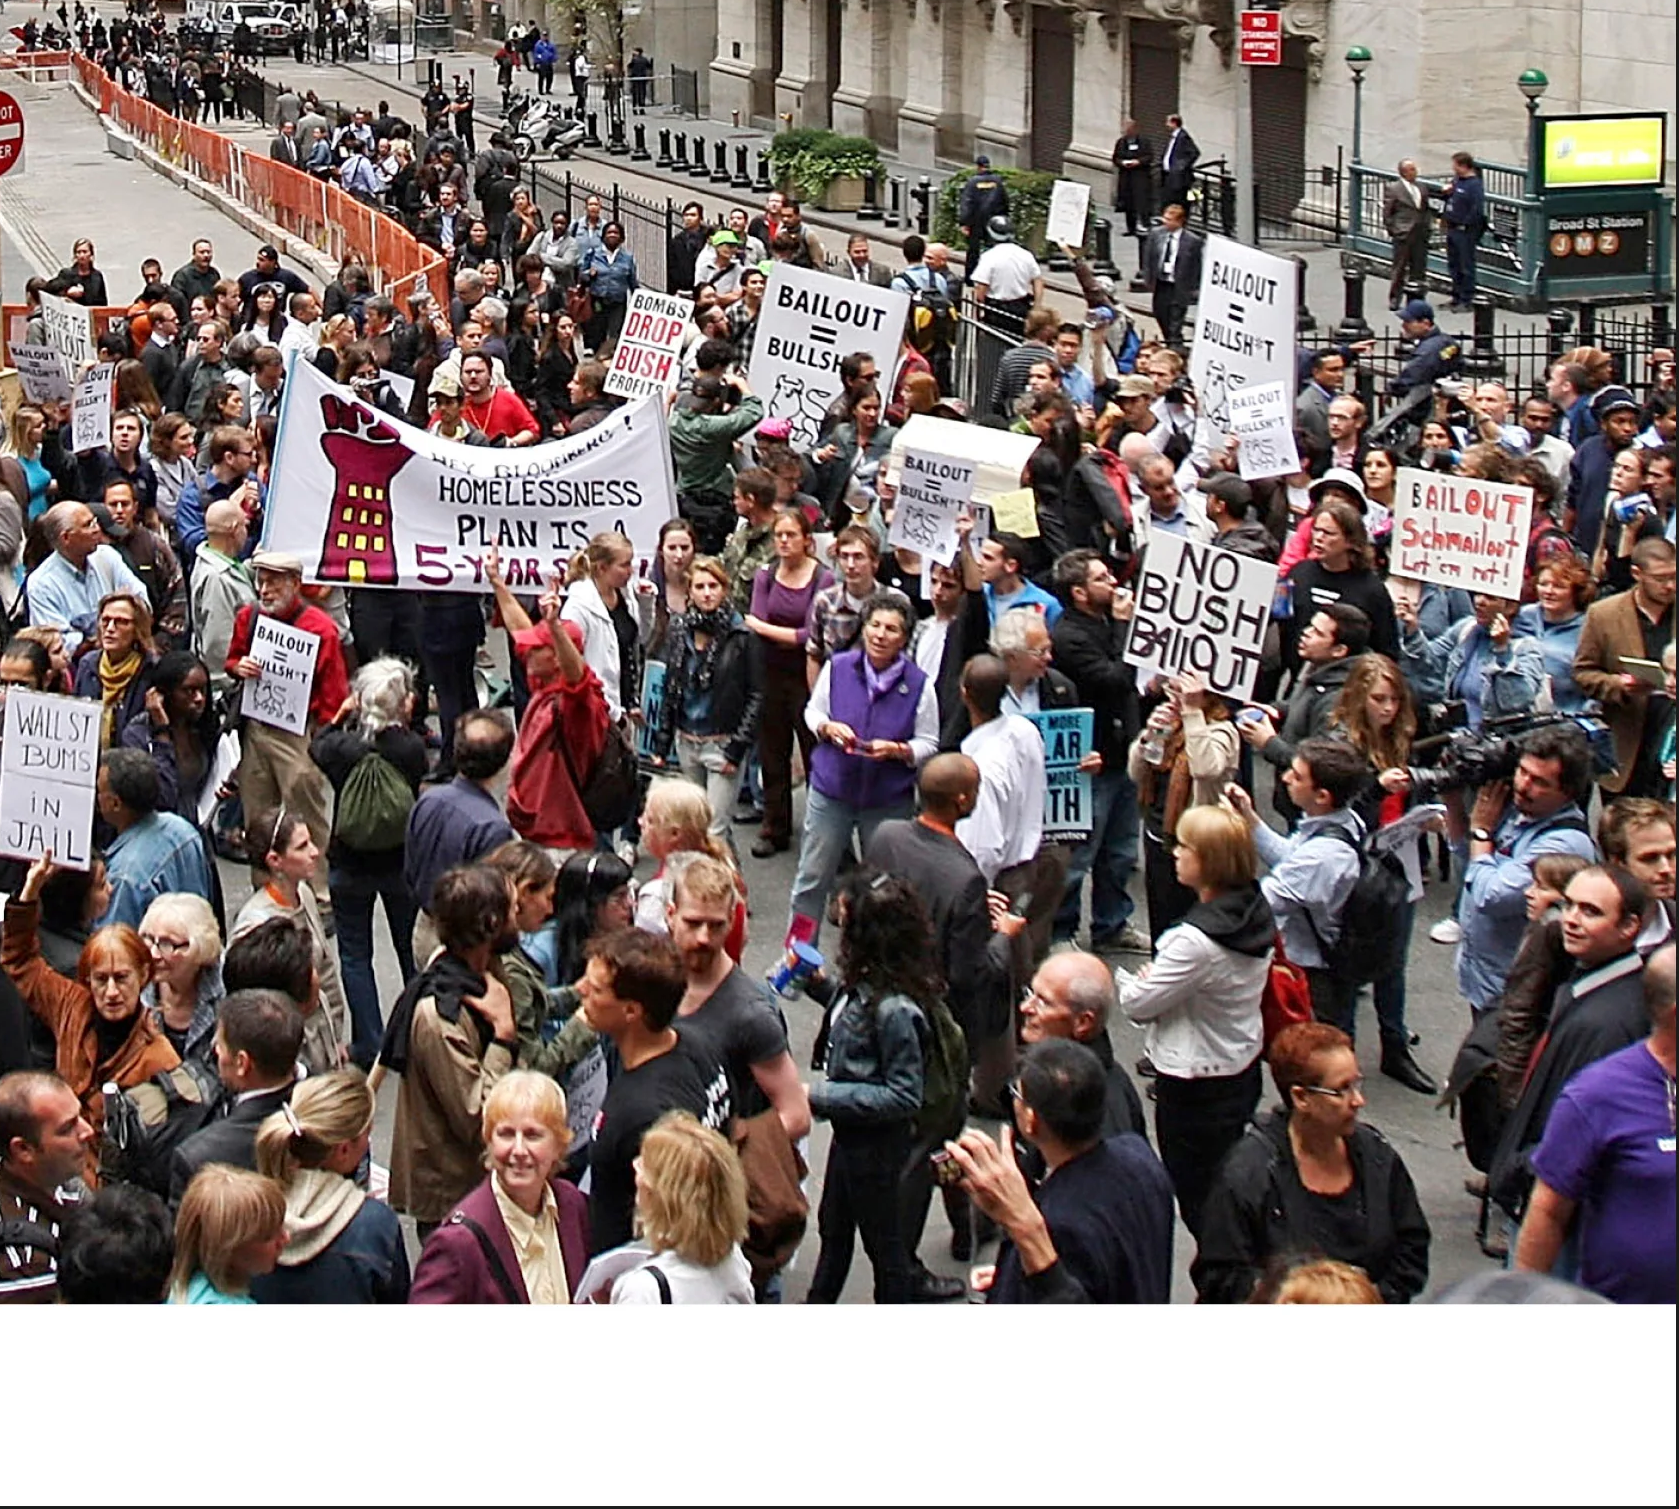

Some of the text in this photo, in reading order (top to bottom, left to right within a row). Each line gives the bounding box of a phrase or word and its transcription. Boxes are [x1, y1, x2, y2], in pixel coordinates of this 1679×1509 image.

[1548, 216, 1644, 231] Broad St Station
[1574, 238, 1593, 251] M
[1212, 260, 1278, 305] BAILOUT
[632, 293, 689, 319] BOMBS
[777, 284, 887, 331] BAILOUT
[626, 312, 683, 345] DROP
[615, 345, 673, 382] BUSH
[1231, 389, 1282, 410] BAILOUT
[905, 454, 973, 483] BAILOUT
[438, 474, 643, 508] HOMELESSNESS
[457, 513, 537, 548] PLAN
[550, 519, 590, 551] IS
[1176, 541, 1240, 593] NO
[1139, 570, 1267, 645] BUSH
[257, 625, 314, 657] BAILOUT
[15, 700, 93, 743] WALL ST
[21, 744, 91, 773] BUMS
